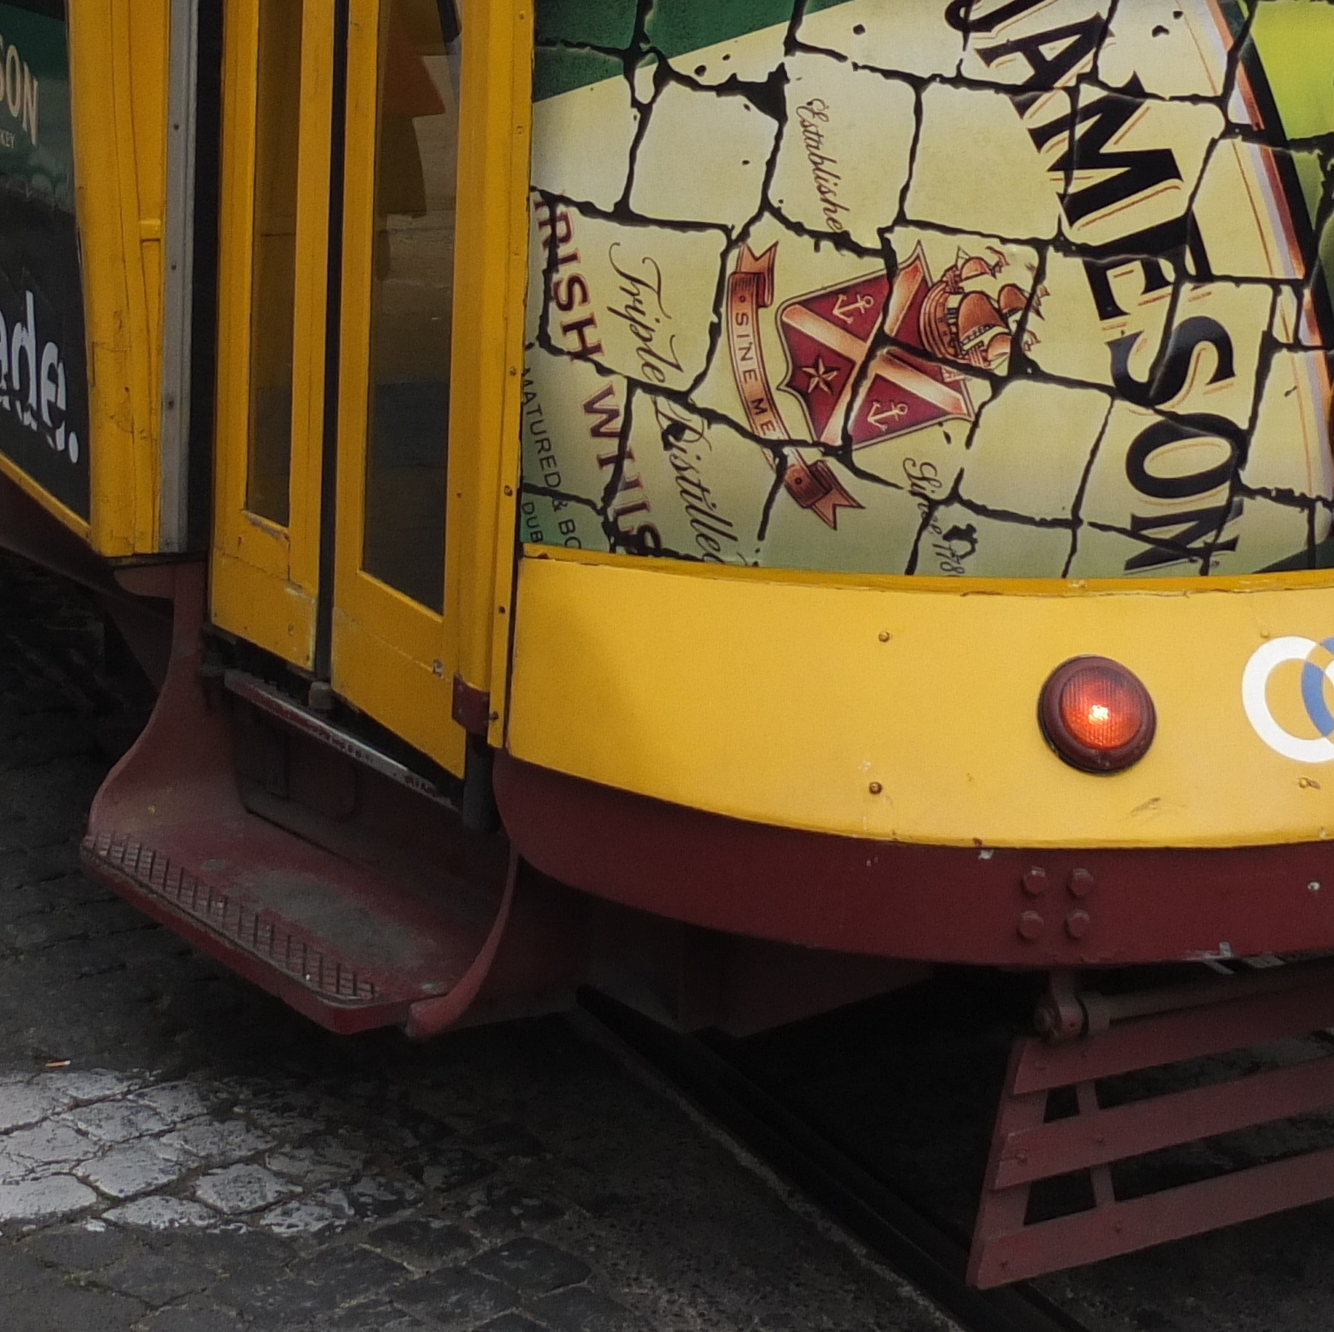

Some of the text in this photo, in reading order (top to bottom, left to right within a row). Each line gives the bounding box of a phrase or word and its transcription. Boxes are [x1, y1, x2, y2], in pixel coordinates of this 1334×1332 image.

[796, 98, 851, 233] Establishe
[607, 242, 685, 384] Triple
[735, 311, 759, 385] SINE
